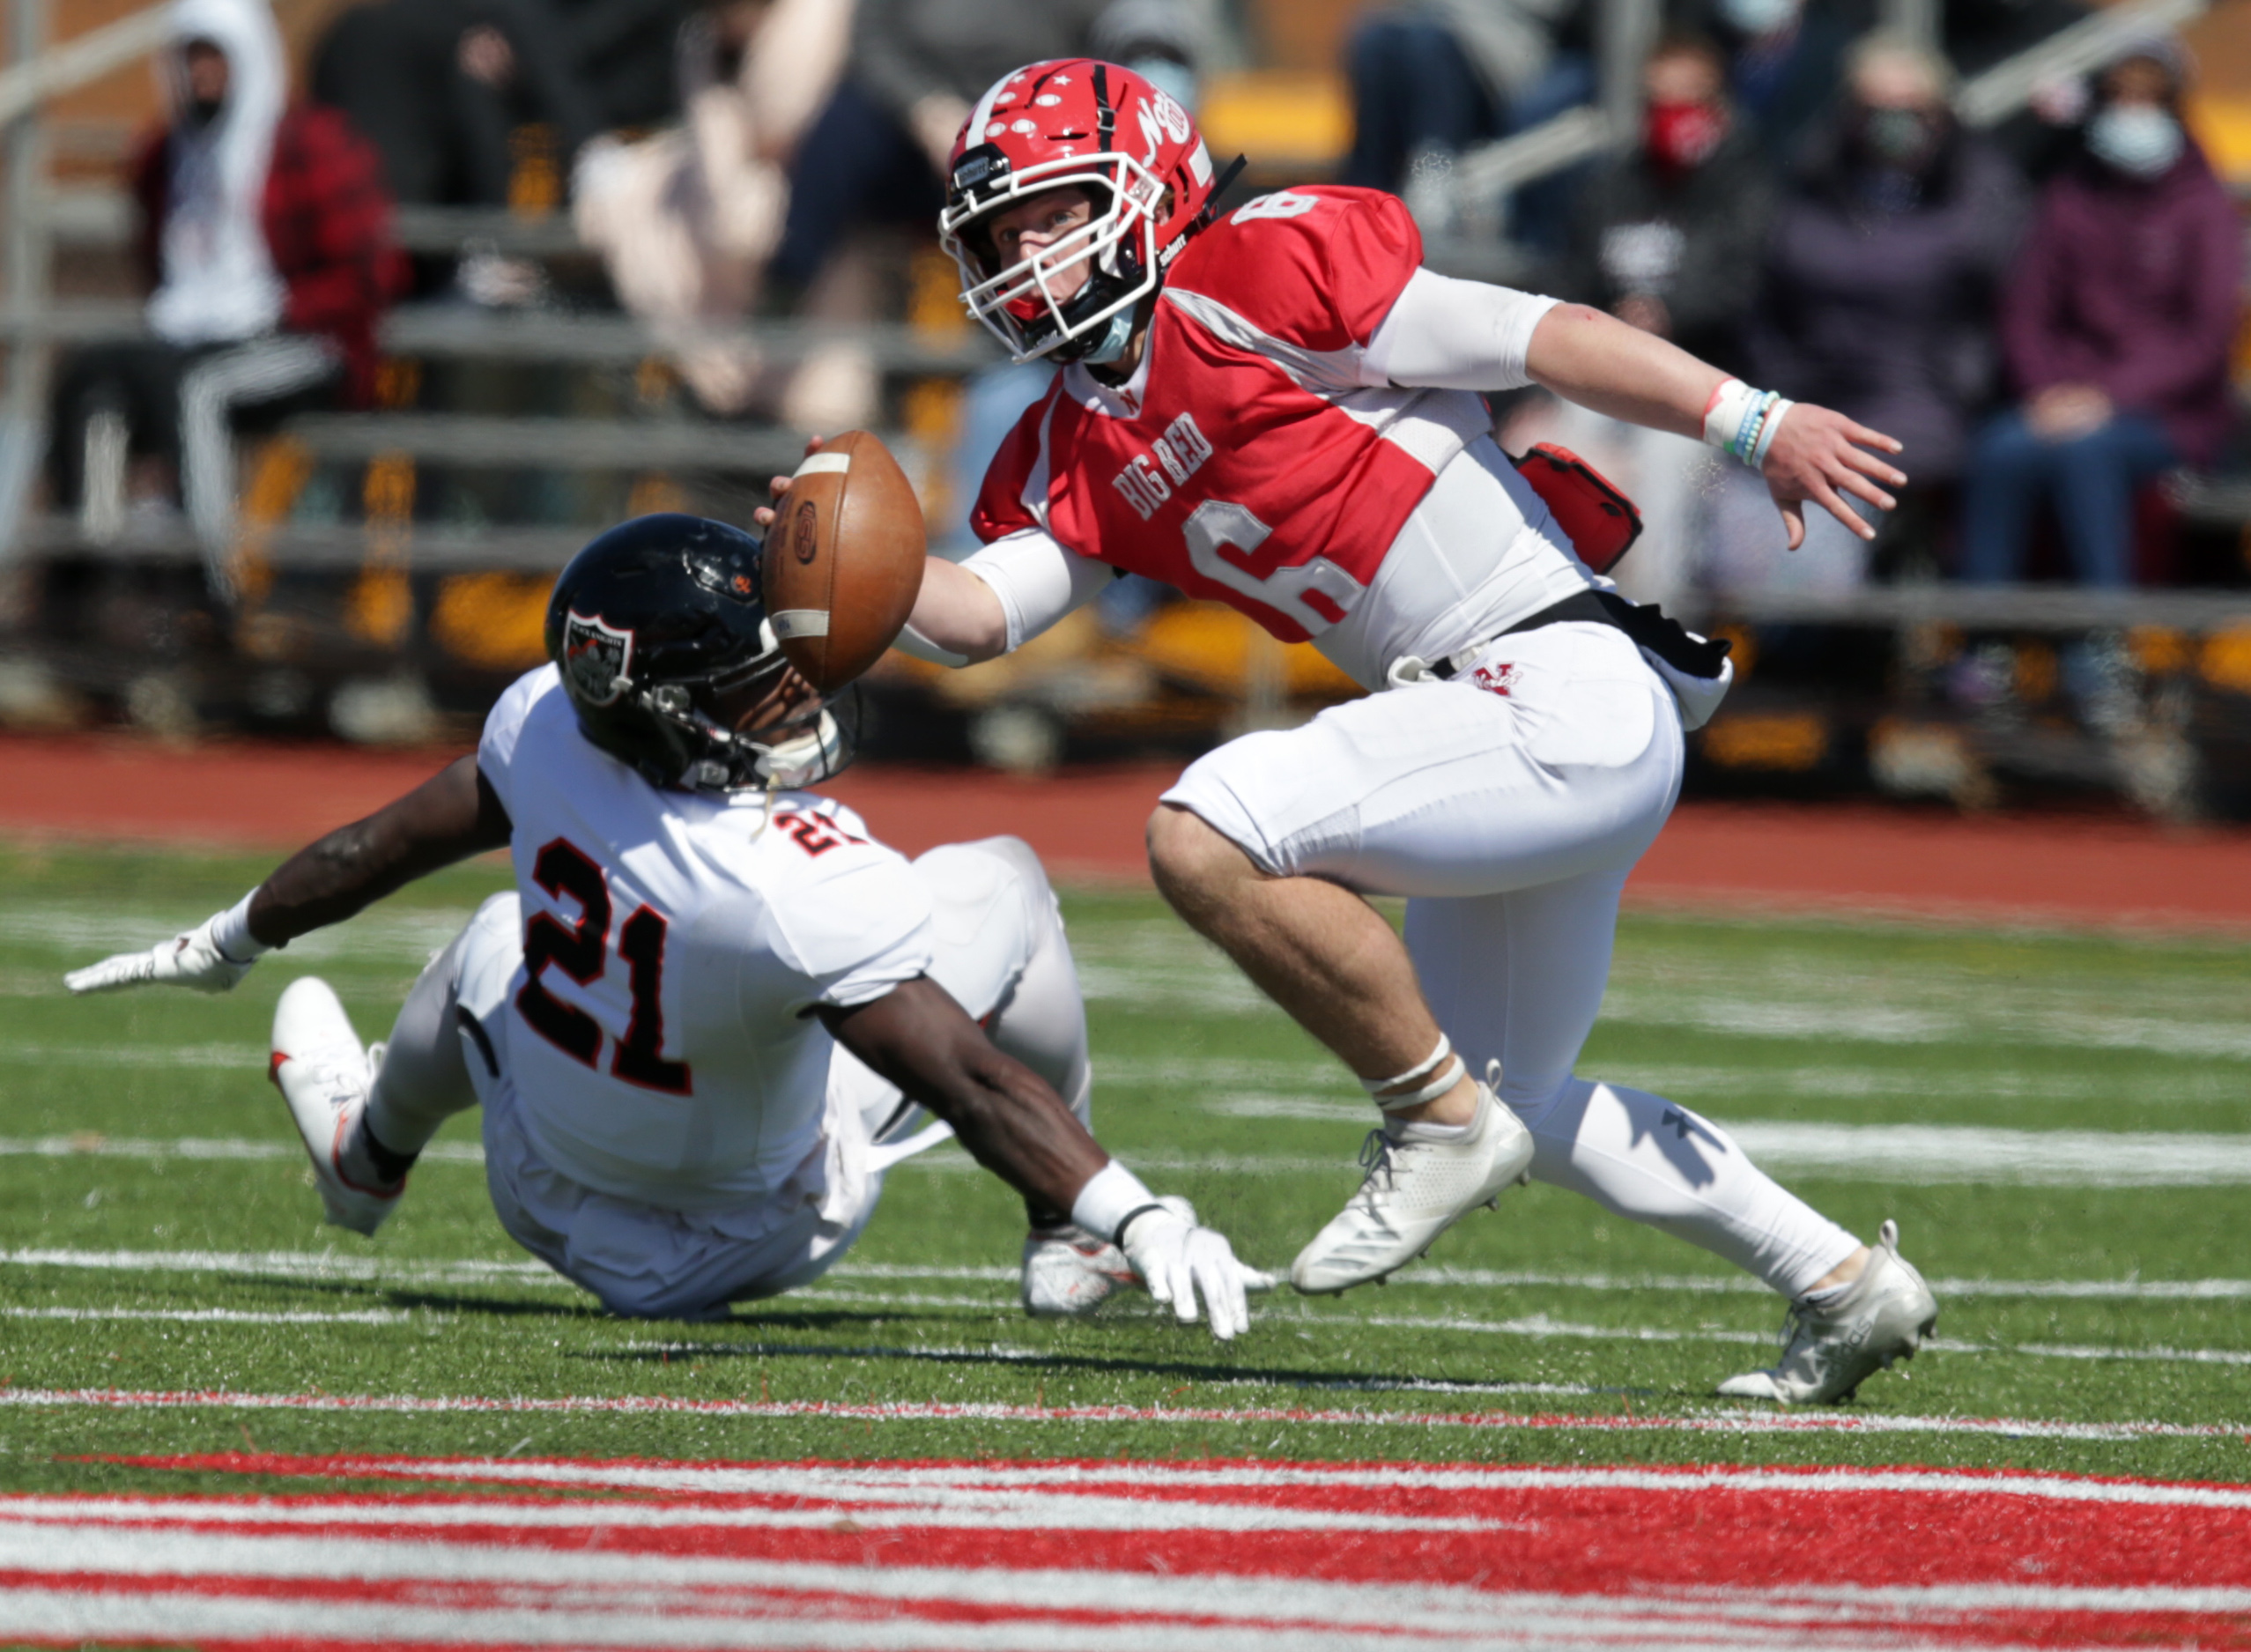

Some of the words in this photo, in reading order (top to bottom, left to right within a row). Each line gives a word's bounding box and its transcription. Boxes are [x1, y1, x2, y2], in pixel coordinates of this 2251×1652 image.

[1159, 233, 1187, 267] schutt
[1120, 389, 1141, 416] N
[1111, 454, 1172, 522] BIG
[1151, 411, 1214, 487] RED
[1181, 499, 1369, 639] 6
[570, 621, 591, 640] BLACK
[590, 630, 623, 648] KNIGHTS
[515, 836, 694, 1097] 21
